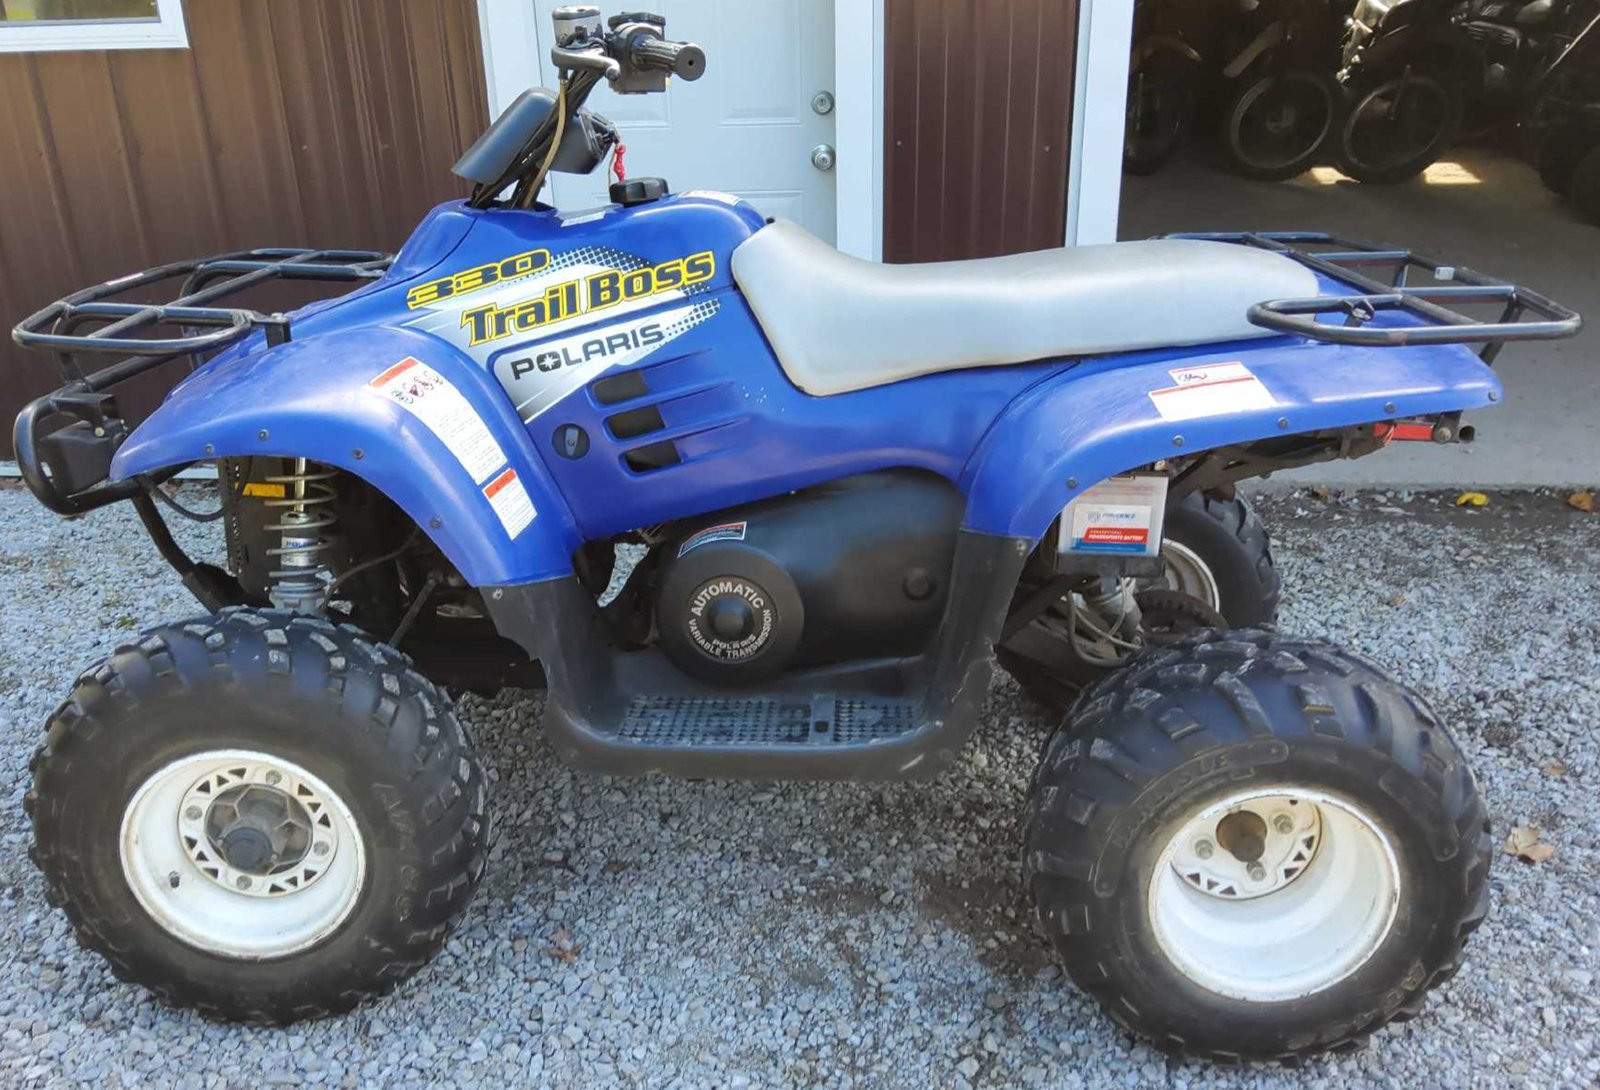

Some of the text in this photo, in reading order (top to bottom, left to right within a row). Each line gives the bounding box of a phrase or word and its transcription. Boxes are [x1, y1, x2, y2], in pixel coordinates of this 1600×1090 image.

[406, 249, 552, 310] 330
[460, 250, 716, 347] Trail Boss
[510, 323, 665, 380] POLARIS
[691, 581, 765, 617] AUTOMATIC
[688, 609, 773, 661] VARIABLE TRANSMISSION
